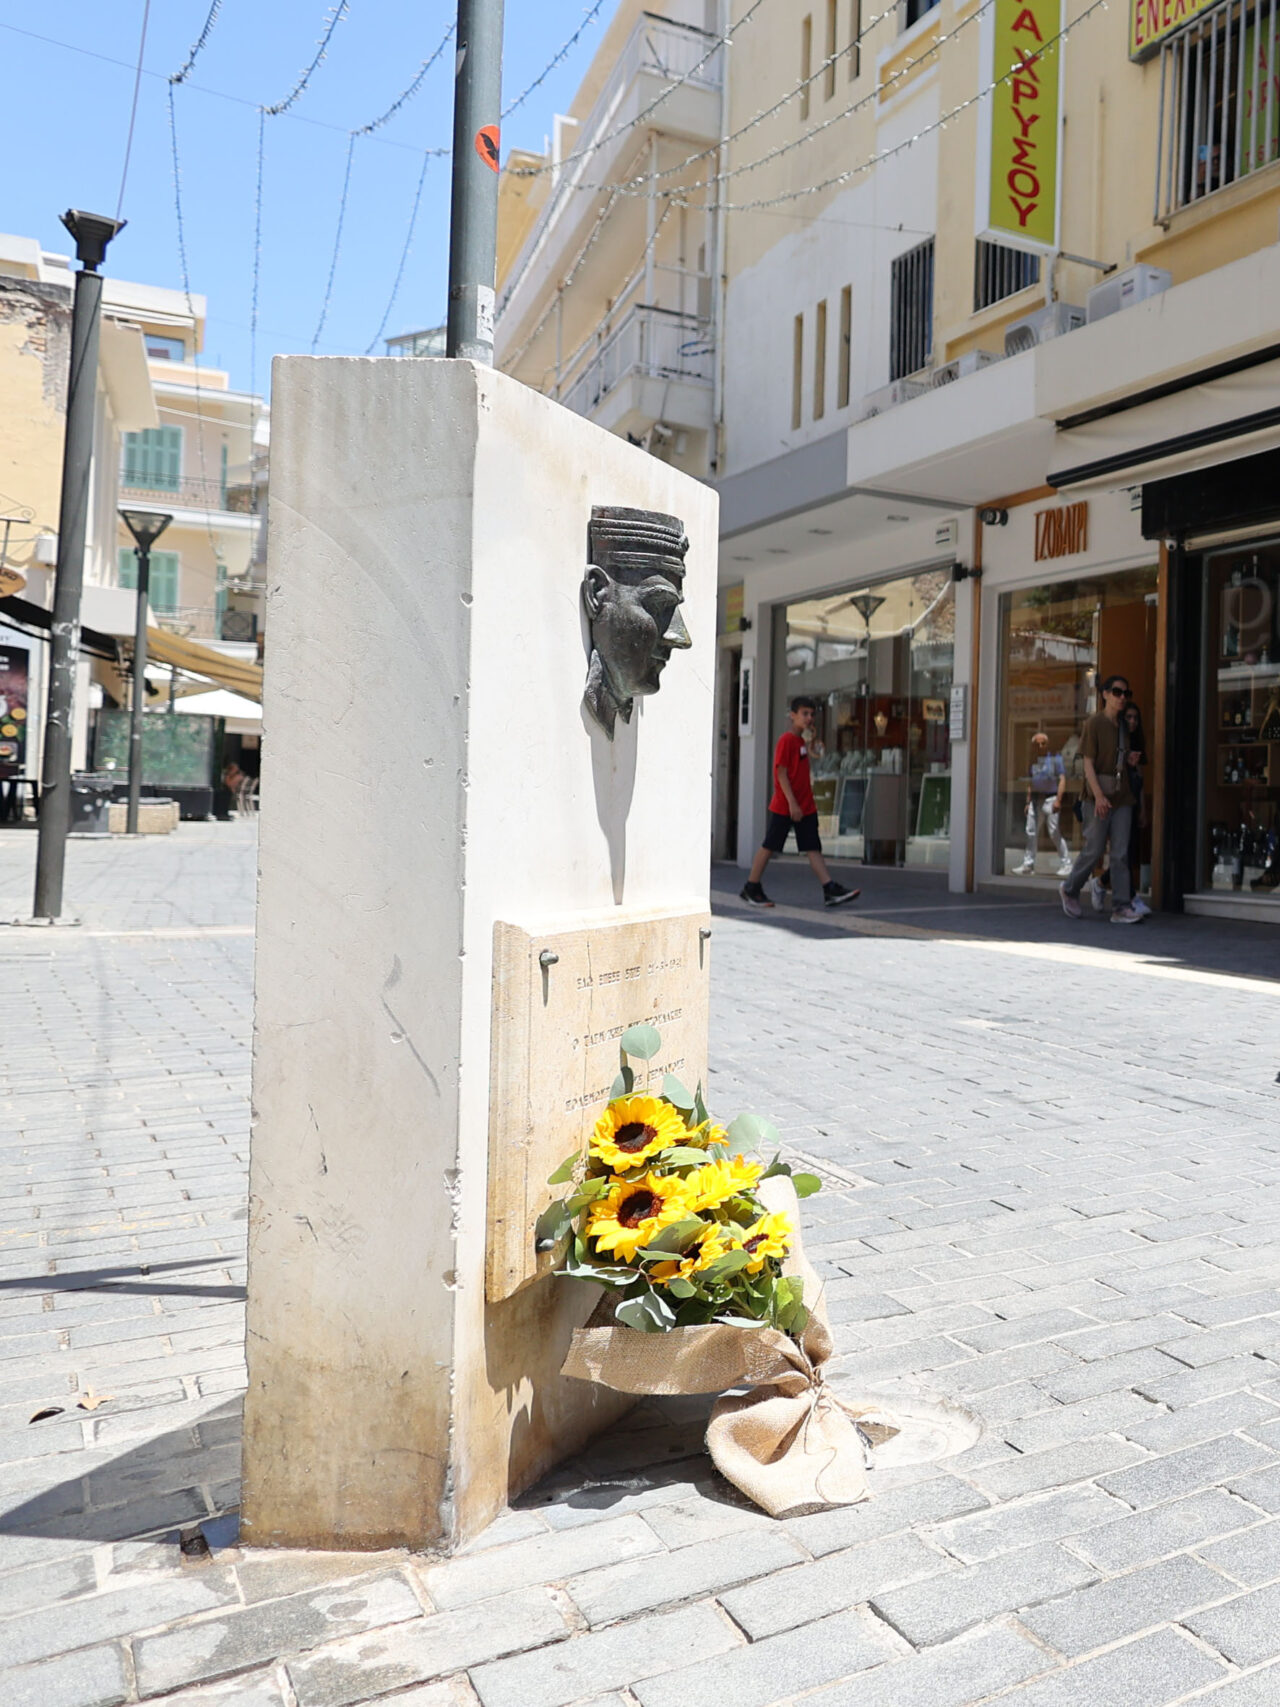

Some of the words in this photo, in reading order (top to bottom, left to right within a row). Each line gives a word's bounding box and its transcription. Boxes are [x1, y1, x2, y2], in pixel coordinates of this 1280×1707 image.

[1011, 0, 1043, 42] Α
[1135, 0, 1197, 46] ΕΝΕ
[1007, 46, 1041, 228] ΧΡΥΣΟΥ
